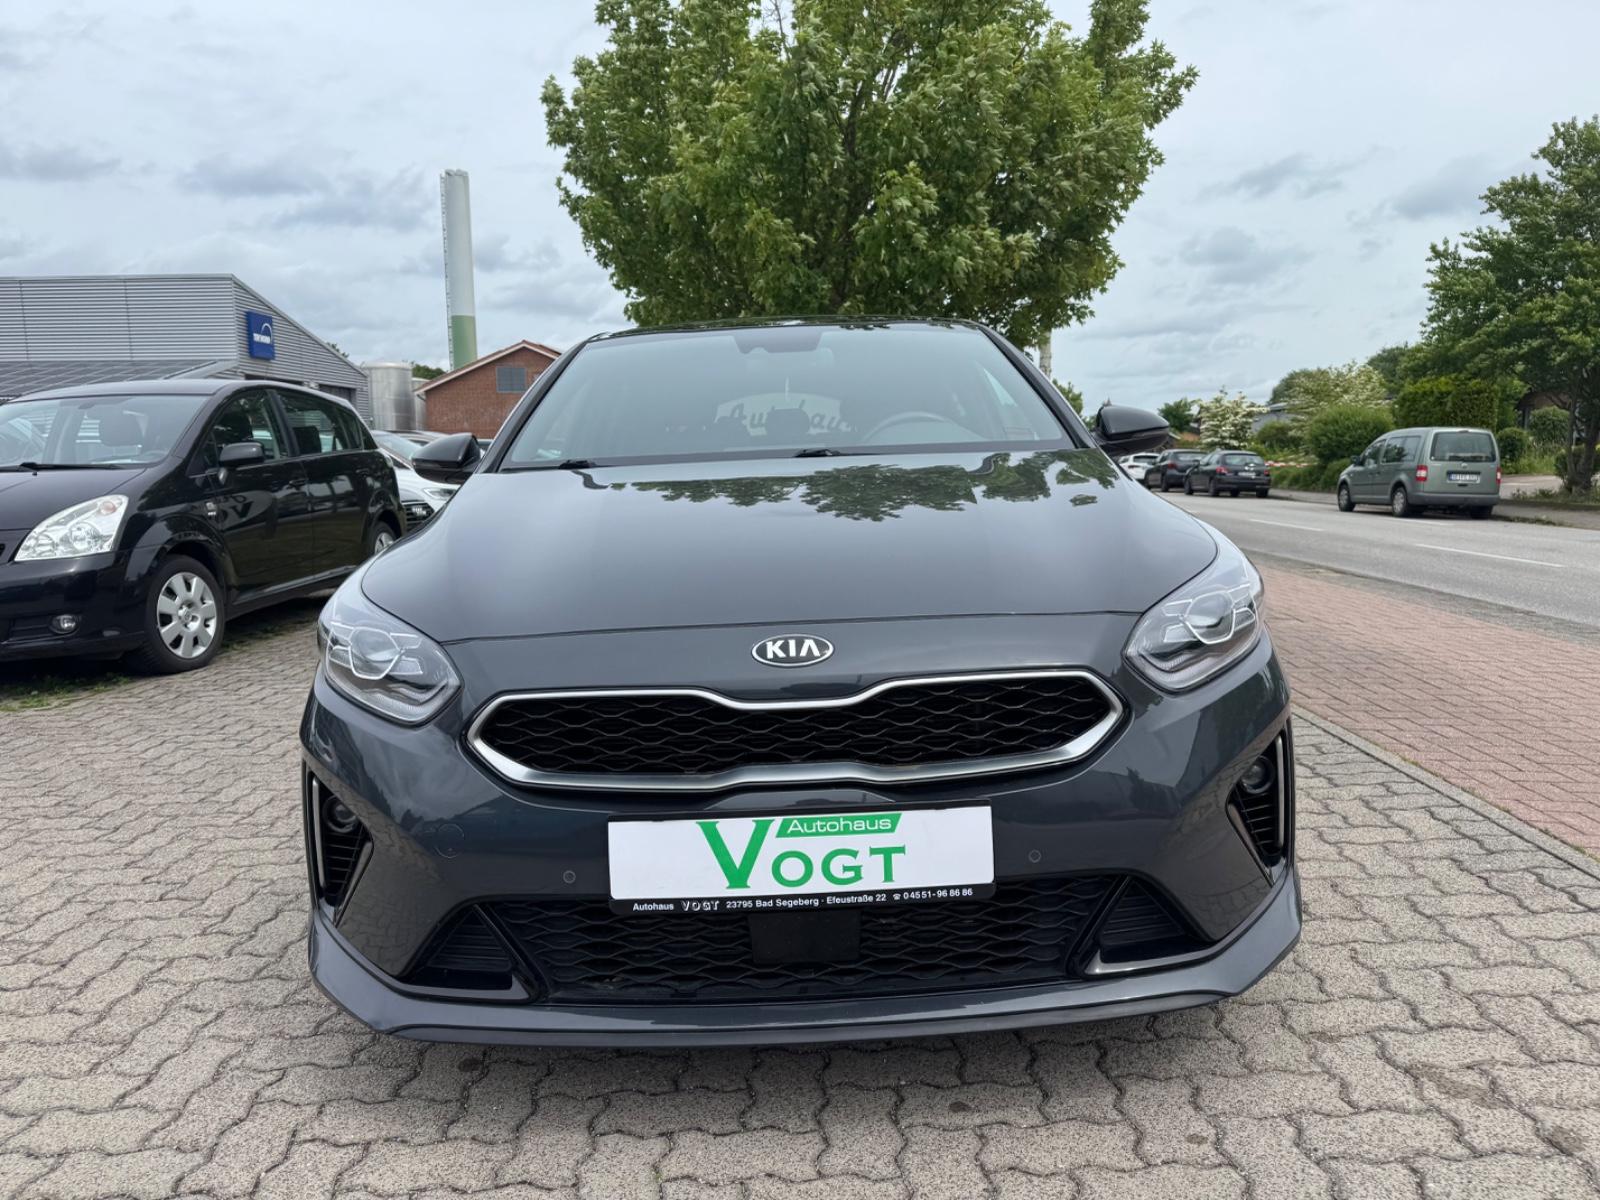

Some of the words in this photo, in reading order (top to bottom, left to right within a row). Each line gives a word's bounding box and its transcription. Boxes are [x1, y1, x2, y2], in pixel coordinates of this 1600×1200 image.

[766, 638, 821, 659] KIA
[787, 817, 892, 834] Autohaus
[696, 819, 906, 889] VOGT
[632, 902, 674, 911] Autohaus
[682, 900, 720, 912] VOGT
[726, 901, 753, 909] 23795
[755, 899, 773, 908] Bad
[775, 896, 819, 908] Segeberg
[826, 893, 874, 905] Efeustraße
[875, 893, 887, 902] 22
